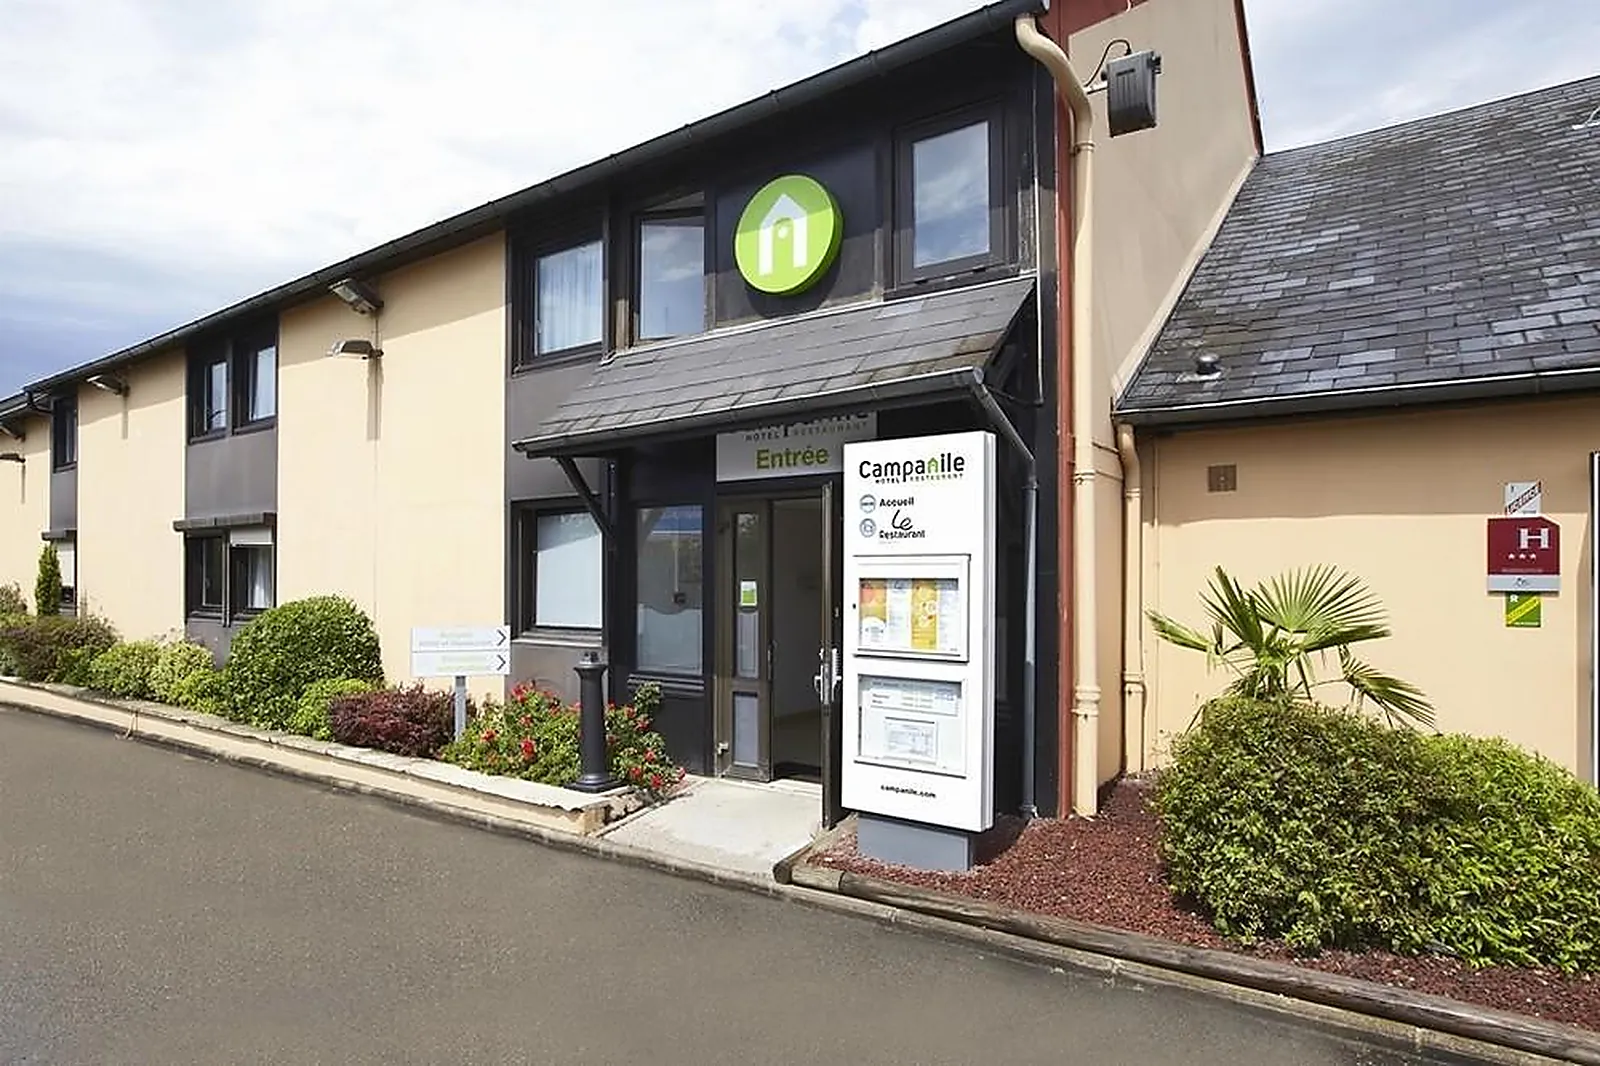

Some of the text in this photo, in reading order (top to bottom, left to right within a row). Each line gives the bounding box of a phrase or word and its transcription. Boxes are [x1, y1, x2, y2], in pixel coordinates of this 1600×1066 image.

[793, 421, 868, 436] RESTAURANT
[755, 446, 829, 469] Entrée
[859, 452, 965, 482] Campanile
[879, 496, 915, 507] Accueil
[891, 509, 913, 530] Le
[879, 530, 926, 539] Restaurant
[1519, 527, 1549, 549] H
